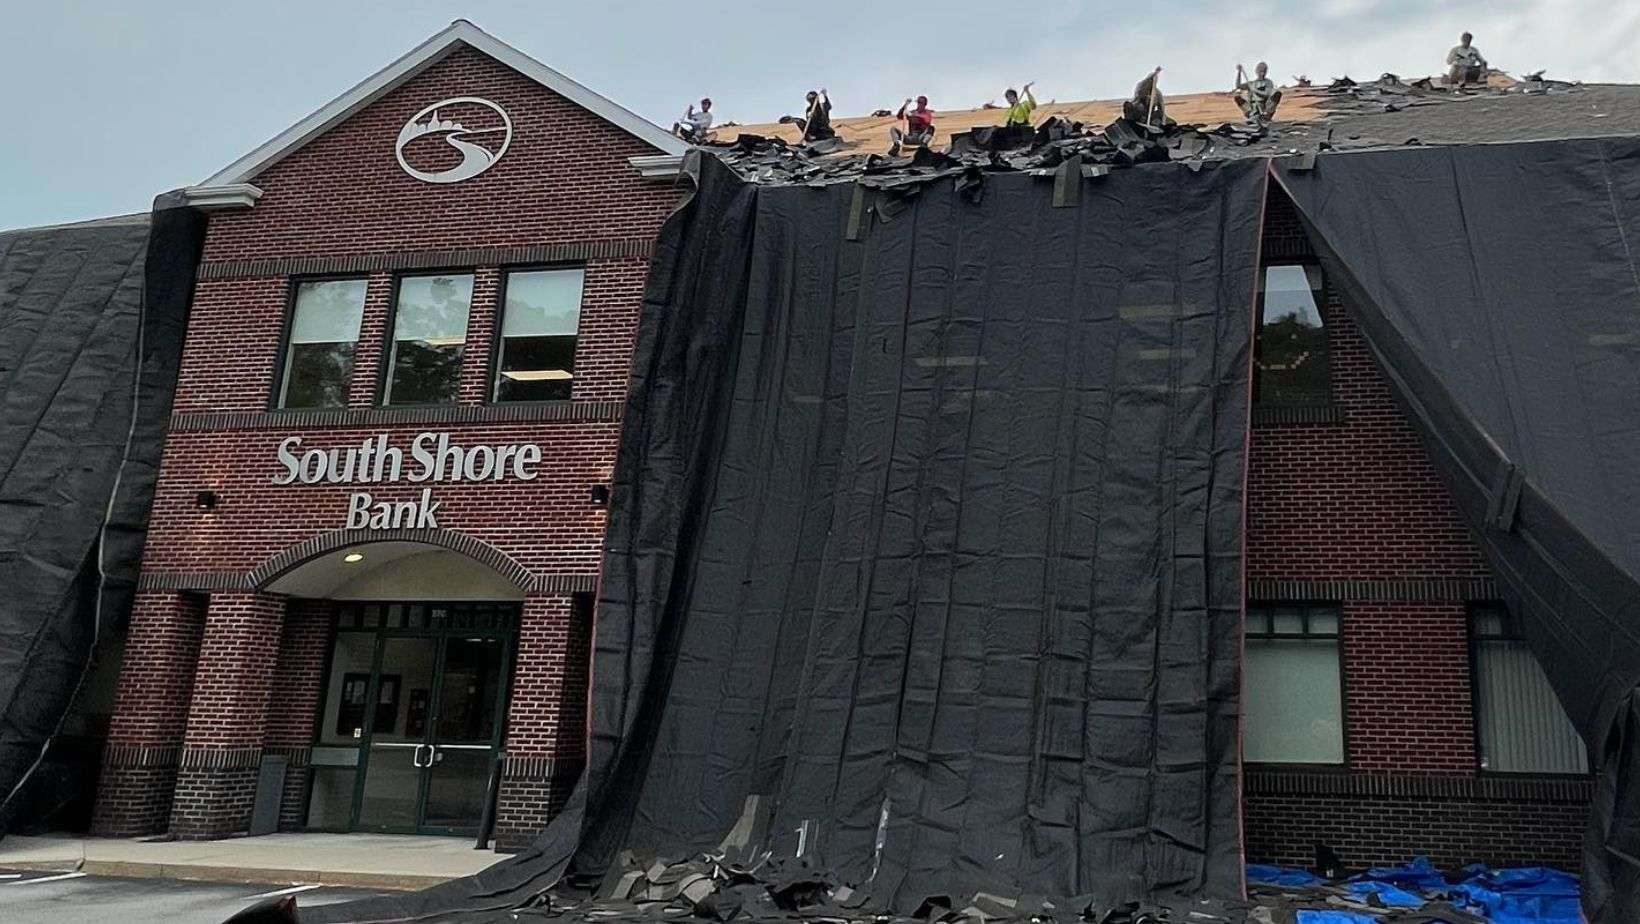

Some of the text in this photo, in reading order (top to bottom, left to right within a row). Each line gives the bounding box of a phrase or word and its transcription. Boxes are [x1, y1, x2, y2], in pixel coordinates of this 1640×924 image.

[273, 432, 542, 485] South Shore
[346, 488, 441, 530] Bank
